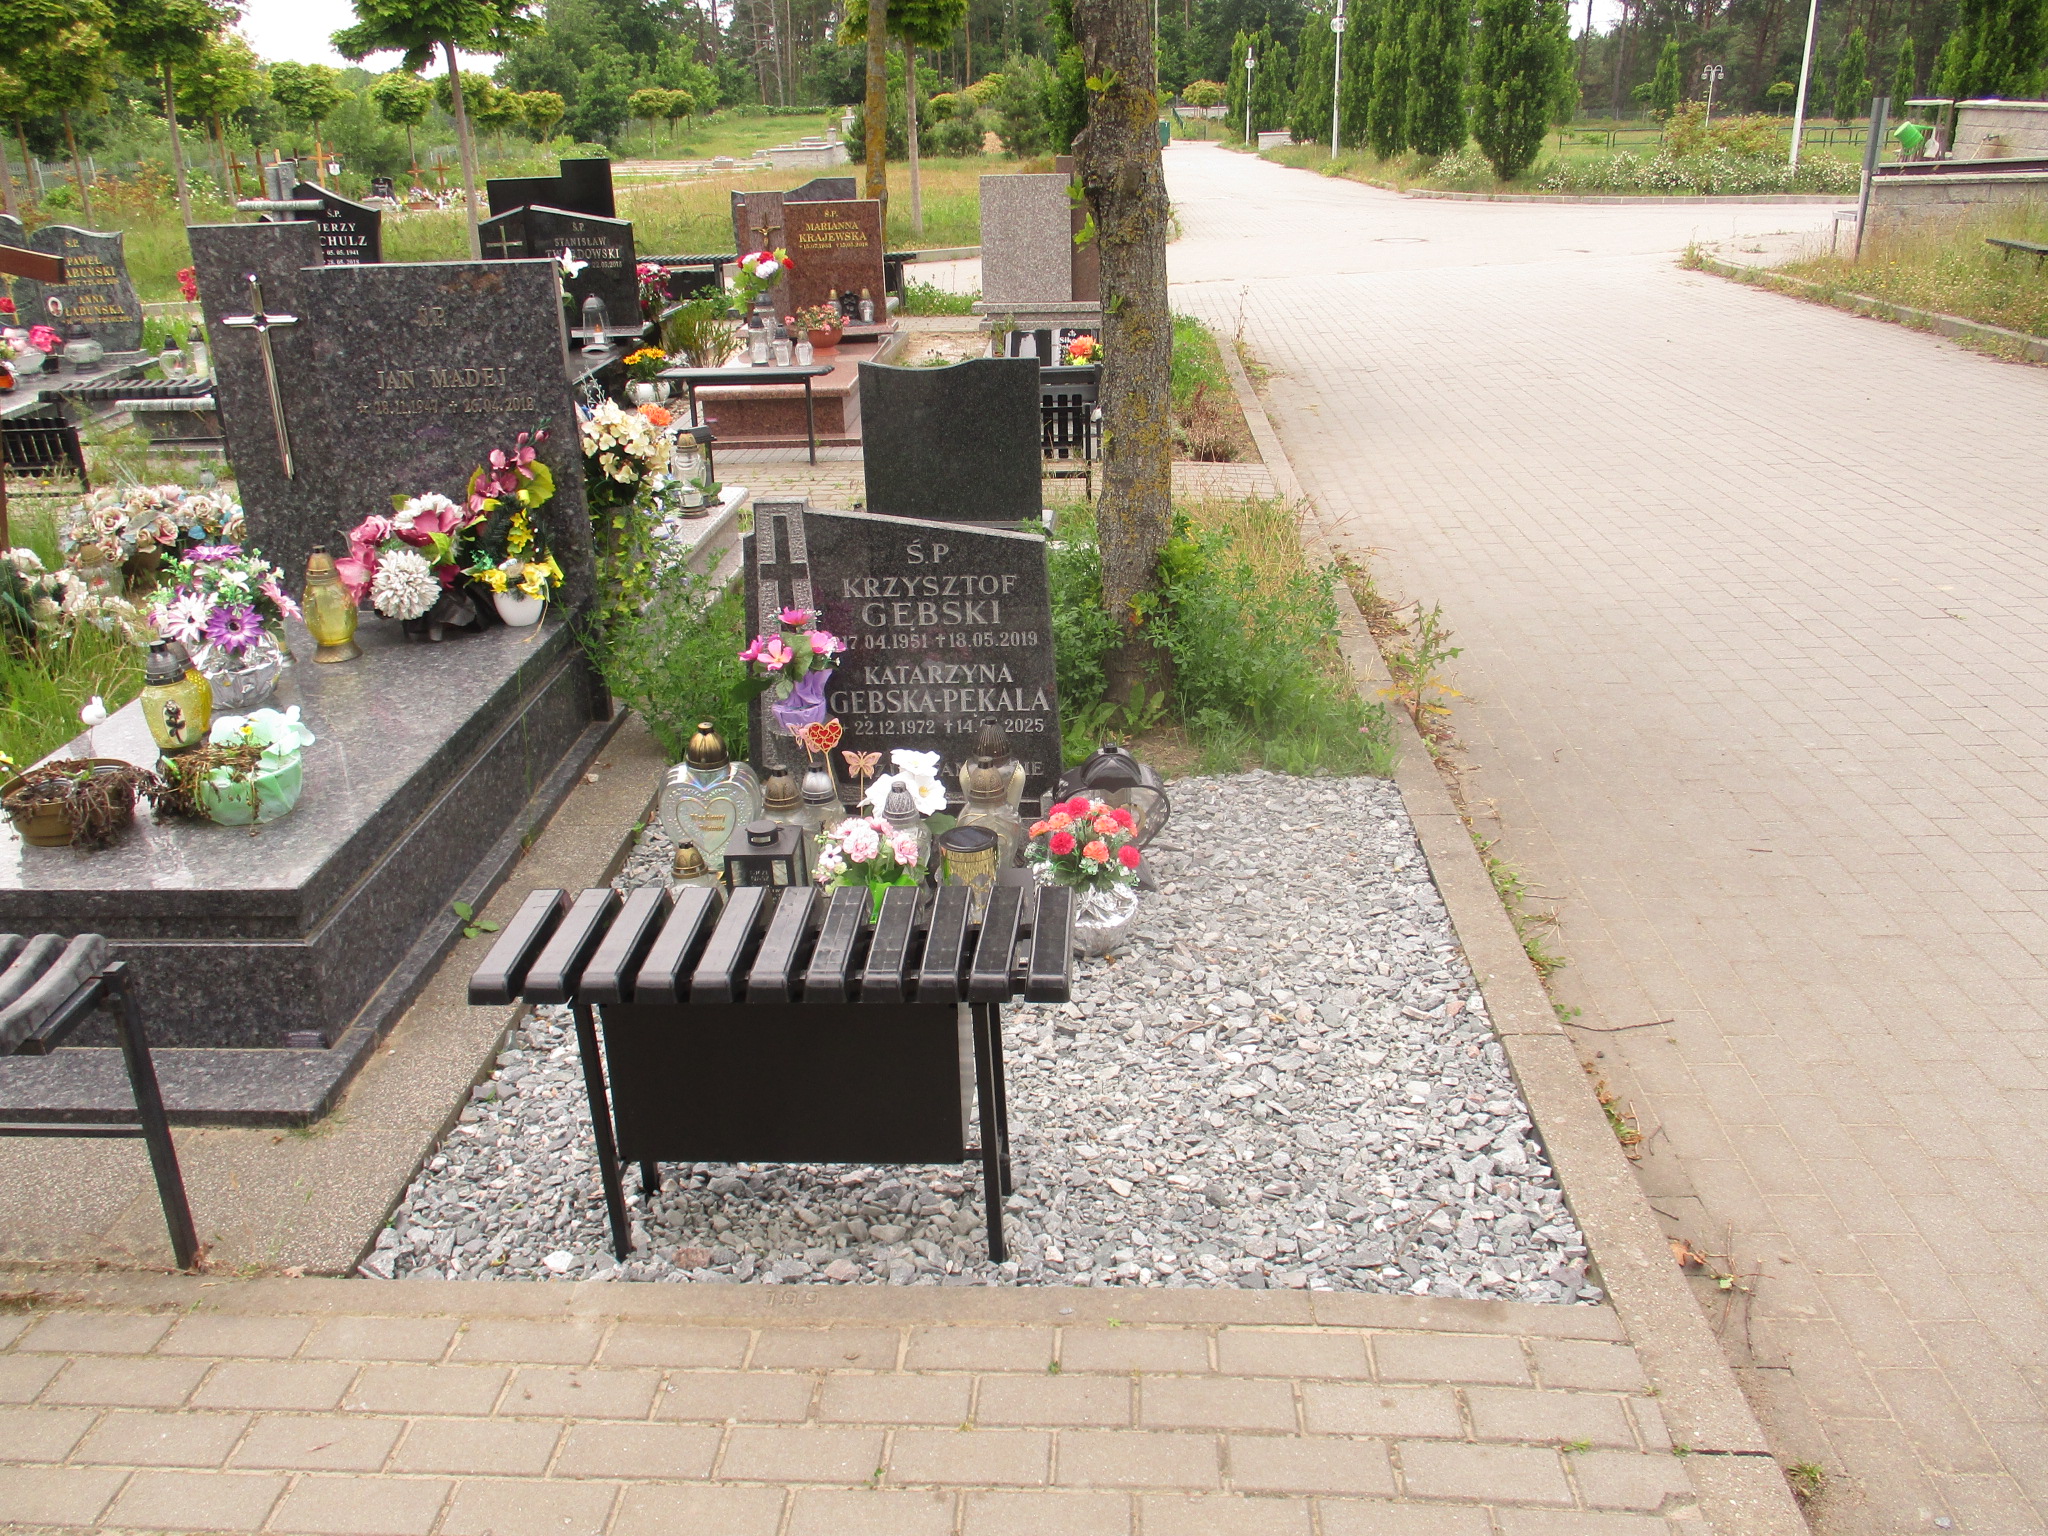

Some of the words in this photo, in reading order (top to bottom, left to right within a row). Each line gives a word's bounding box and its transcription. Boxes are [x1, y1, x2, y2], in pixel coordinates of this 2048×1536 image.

[805, 221, 859, 231] MARIANNA
[319, 235, 368, 246] CHULZ
[798, 231, 867, 242] KRAJEWSKA
[544, 248, 620, 260] TWRDOWSKI
[78, 295, 106, 304] ANNA
[377, 370, 416, 390] JAN
[429, 367, 507, 388] MADEJ
[842, 573, 1018, 598] KRZYSZTOF
[861, 600, 1001, 631] GĘBSKI
[864, 662, 1014, 685] KATARZYNA
[854, 719, 935, 735] 22.12.1972
